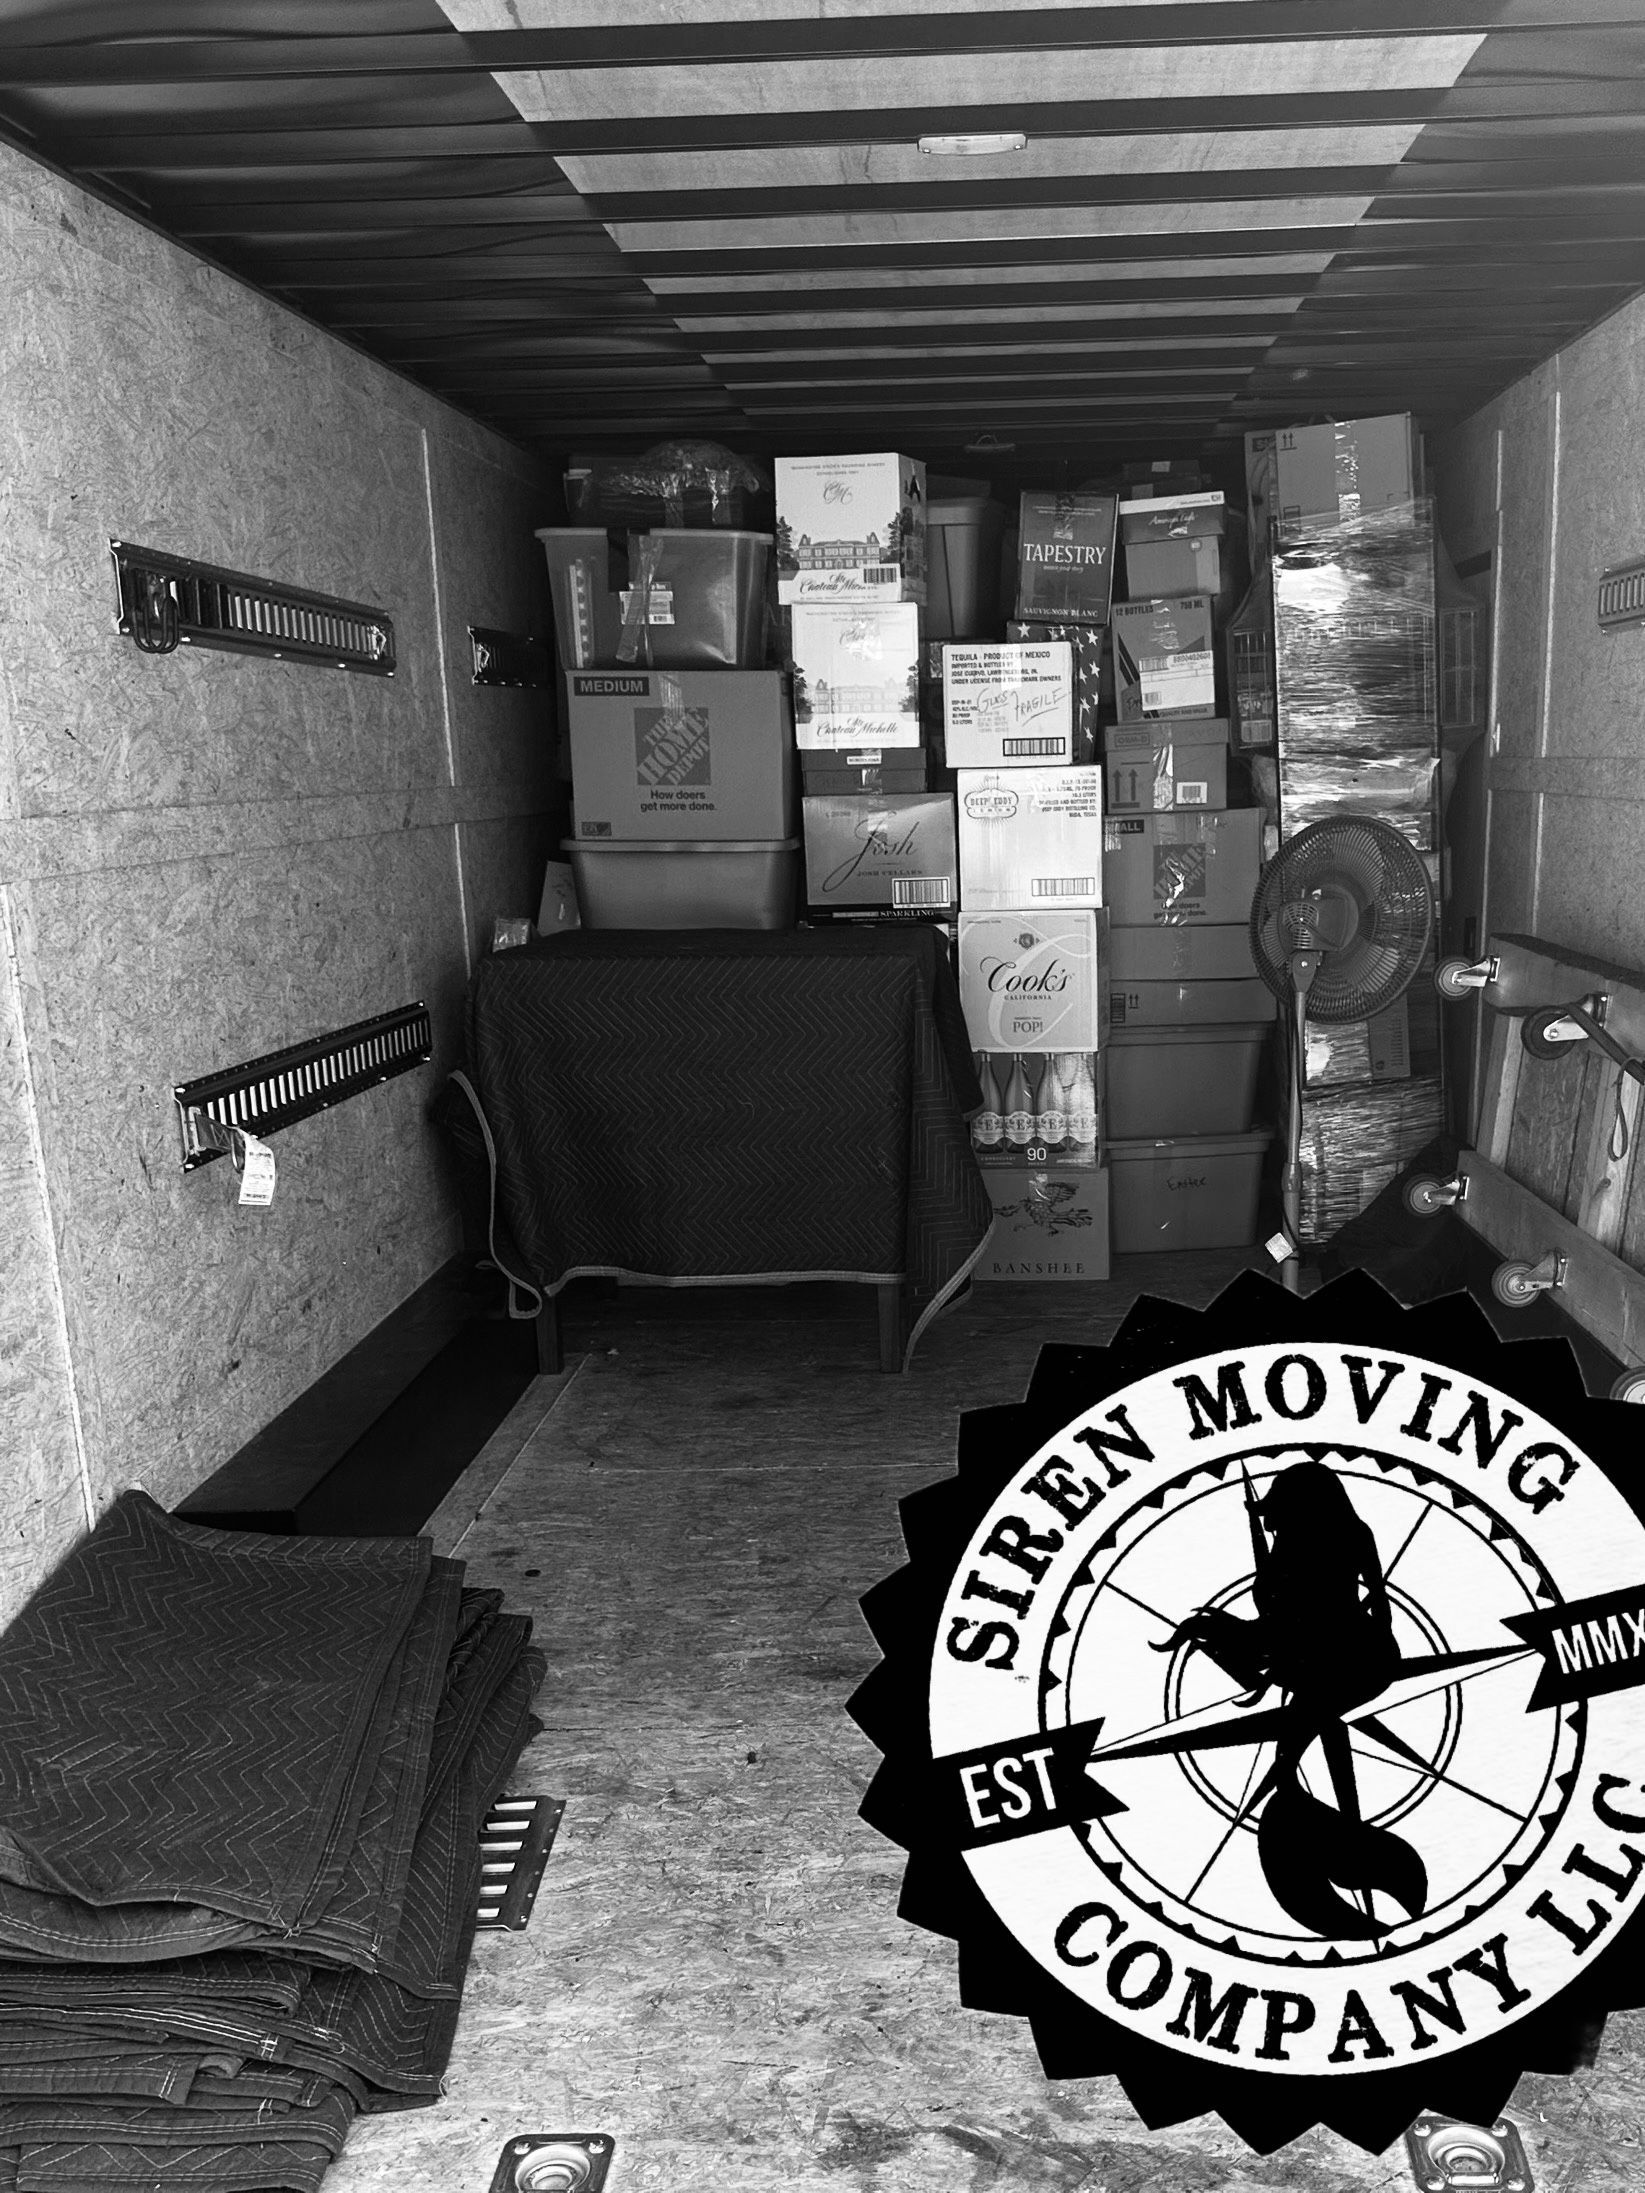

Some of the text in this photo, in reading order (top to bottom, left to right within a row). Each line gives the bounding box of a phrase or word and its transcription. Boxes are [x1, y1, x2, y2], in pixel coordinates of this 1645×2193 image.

[1024, 543, 1106, 564] TAPESTRY
[1024, 607, 1098, 618] SAUVIGNON BLANC
[1125, 605, 1154, 615] BOTTLES
[1194, 600, 1204, 609] ML
[984, 652, 1014, 660] PRODUCT
[1026, 651, 1051, 659] MEXICO
[580, 680, 643, 692] MEDIUM
[1011, 688, 1072, 722] FRAGILE
[817, 721, 898, 738] Chateau Michelle
[637, 709, 709, 784] HOME
[666, 736, 710, 785] DEPOT
[650, 790, 706, 800] How doers
[994, 796, 1013, 805] EDDY
[640, 802, 658, 812] get
[689, 801, 716, 810] done.
[822, 810, 920, 893] Josh
[880, 910, 934, 918] SPARKLING
[980, 956, 1073, 992] Cook's
[1013, 1021, 1044, 1033] POP!
[1027, 1148, 1047, 1160] 90
[993, 1262, 1086, 1274] BANSHEE
